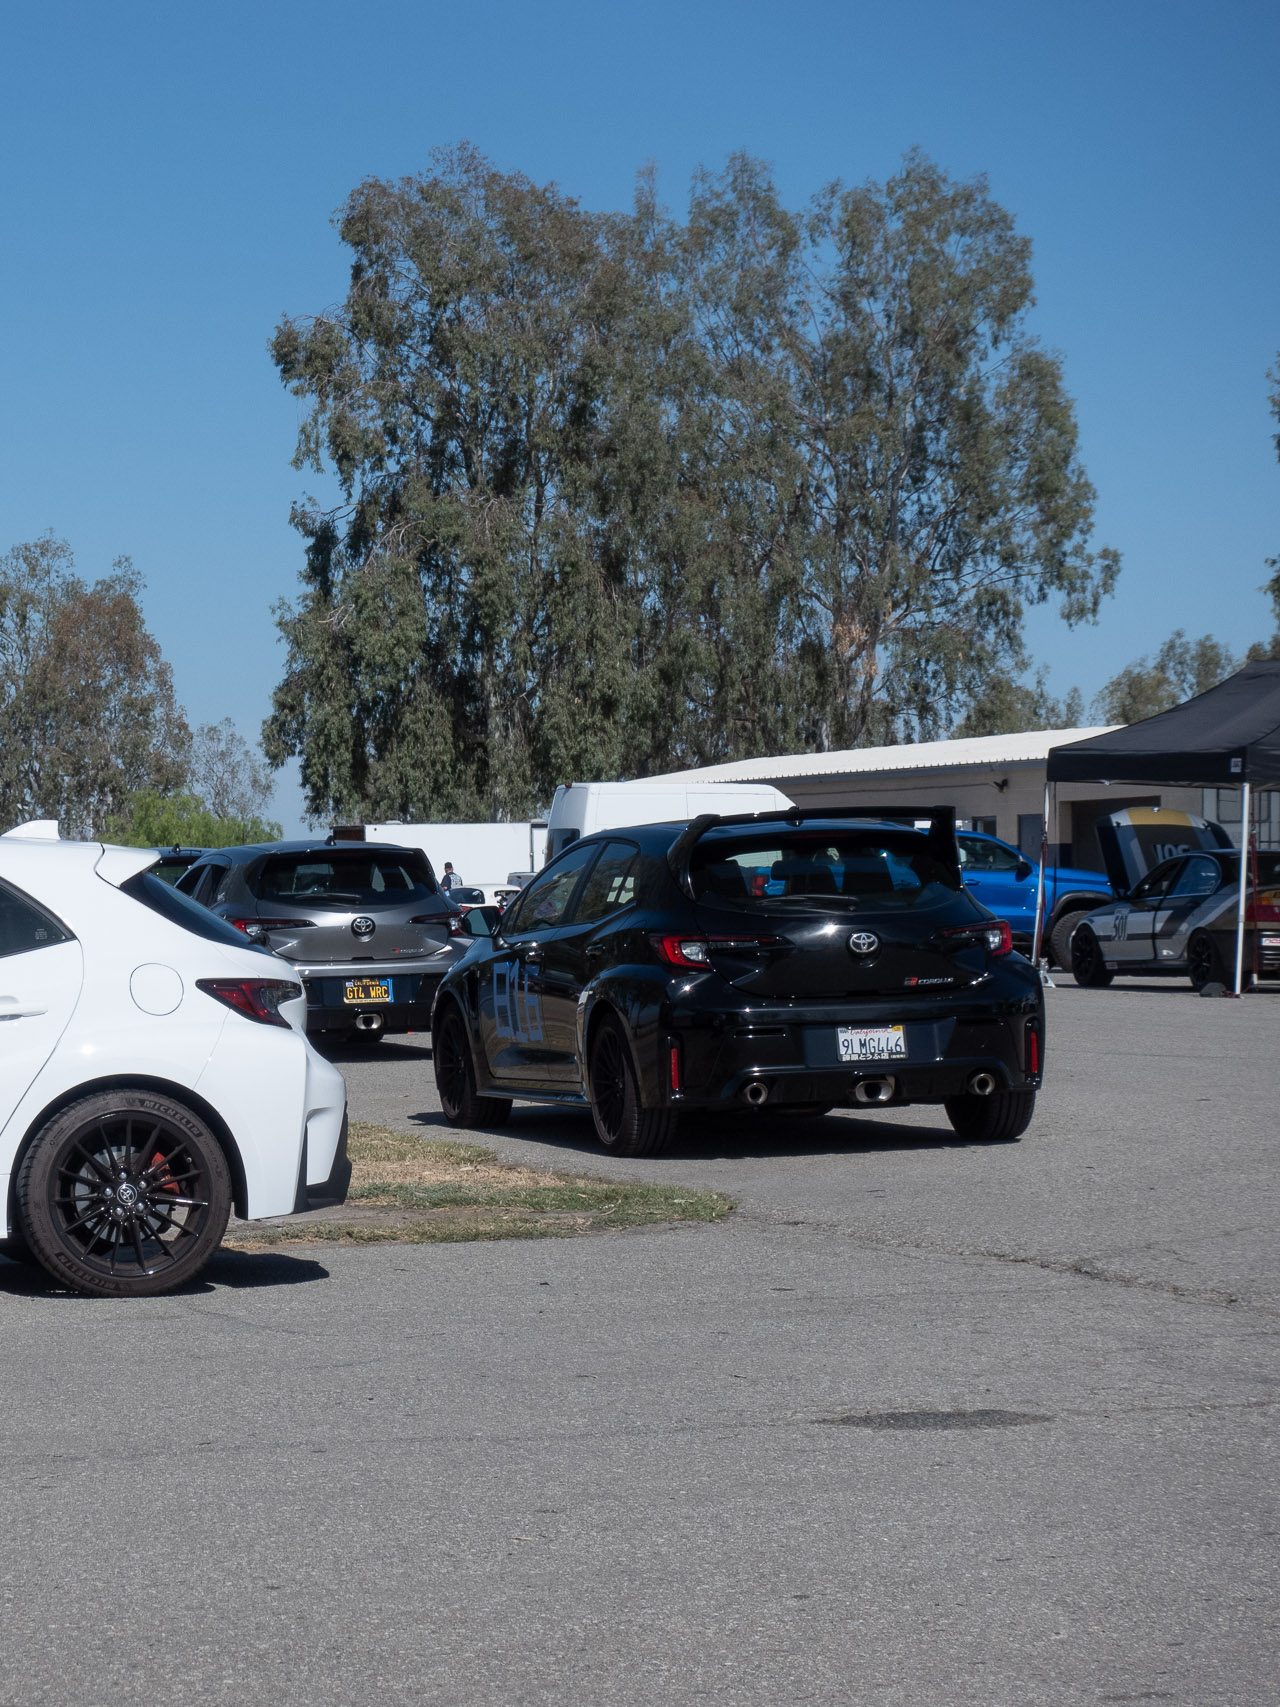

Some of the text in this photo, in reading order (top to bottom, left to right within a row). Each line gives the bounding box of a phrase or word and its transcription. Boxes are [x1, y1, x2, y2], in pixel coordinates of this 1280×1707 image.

[346, 986, 388, 999] GT4 WRC
[841, 1036, 903, 1055] 9LMG446
[143, 1100, 200, 1135] MICHELIN
